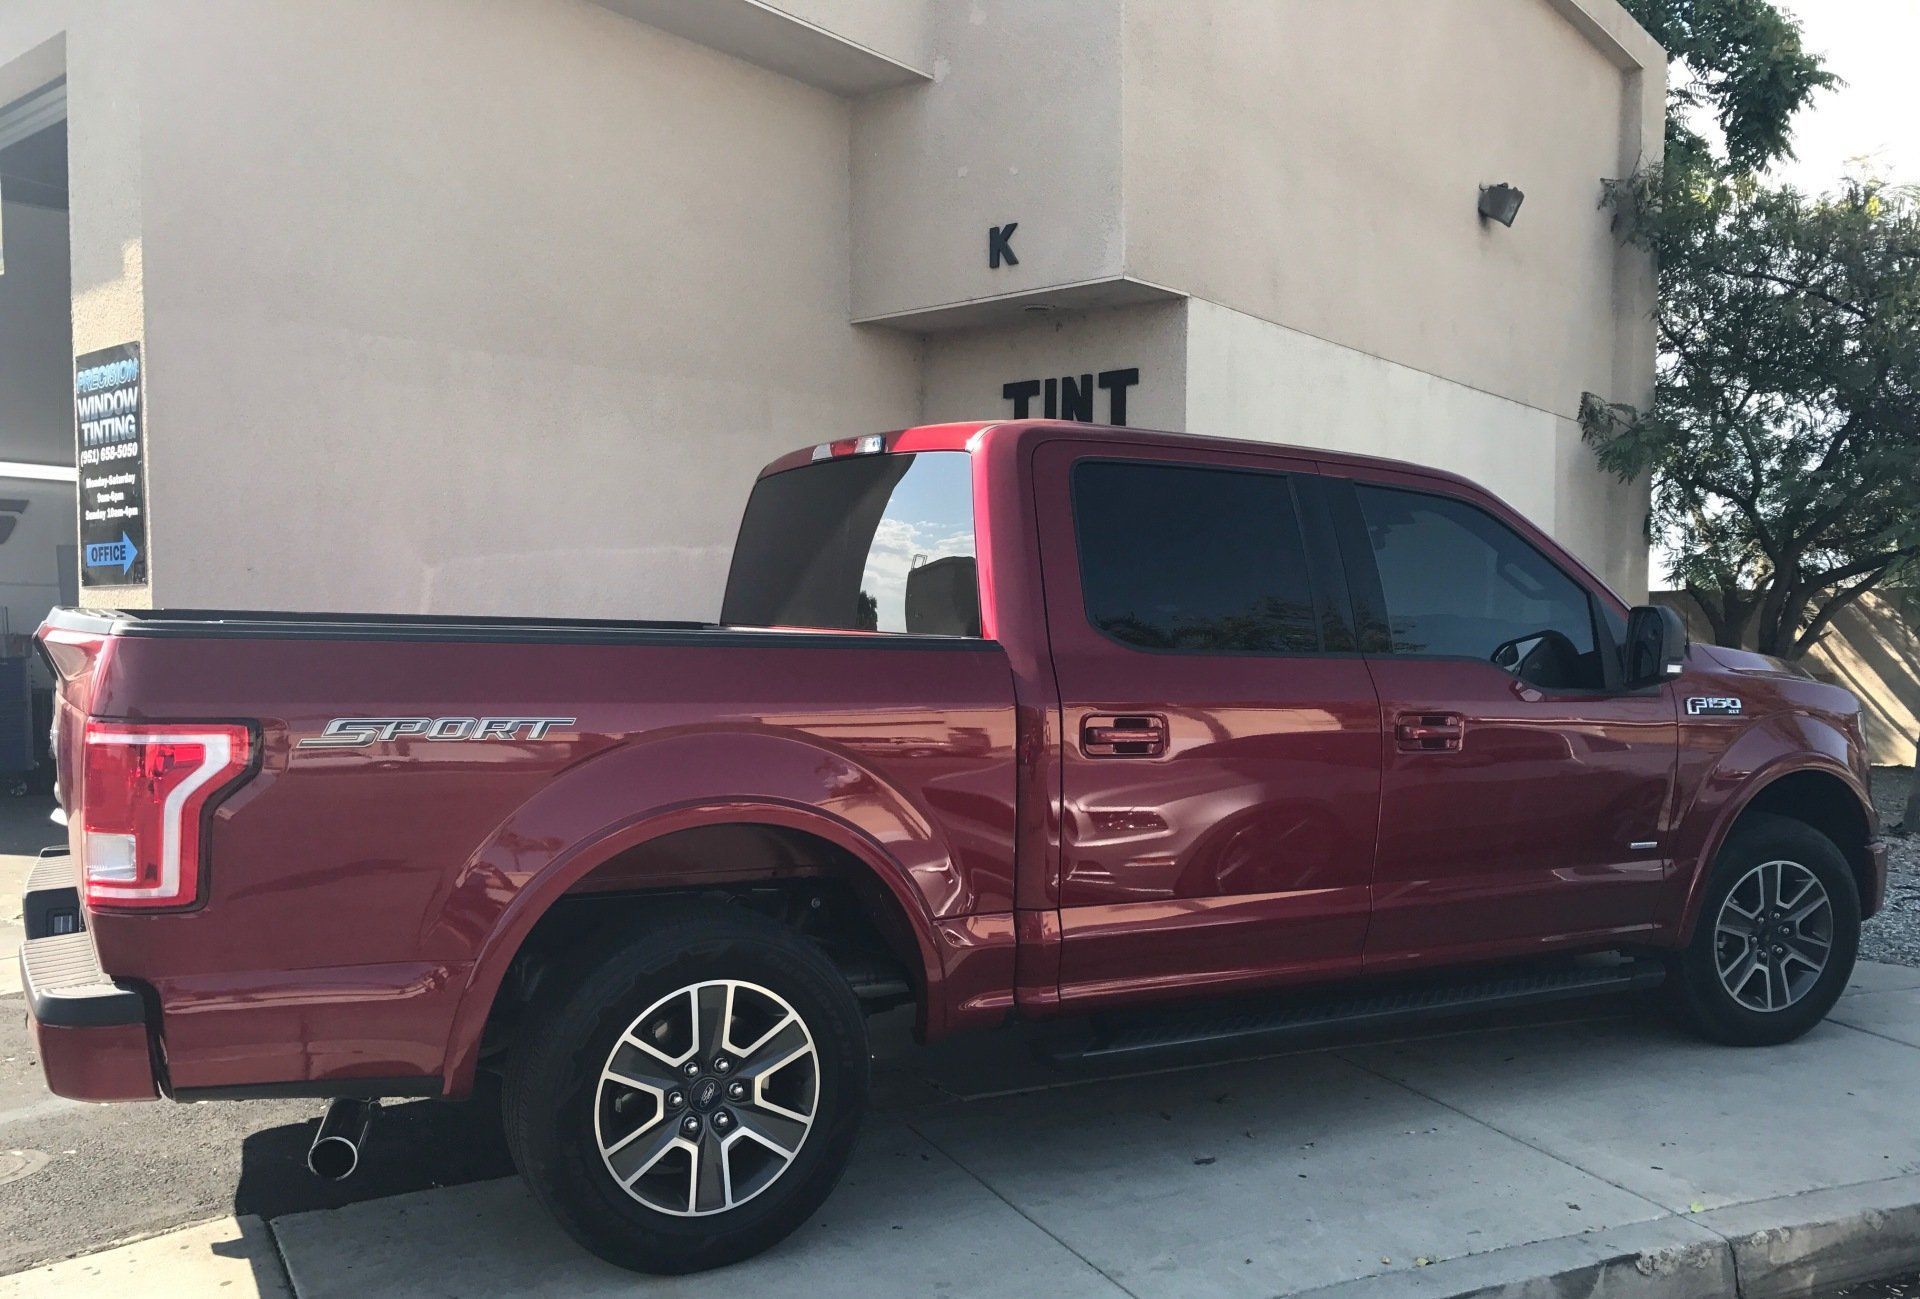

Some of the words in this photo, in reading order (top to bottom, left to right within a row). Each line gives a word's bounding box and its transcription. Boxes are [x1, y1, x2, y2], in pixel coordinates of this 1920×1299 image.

[989, 222, 1020, 269] K
[77, 358, 139, 393] PRECISION
[77, 386, 138, 421] WINDOW
[1003, 368, 1140, 426] TINT
[81, 413, 136, 447] TINTING
[91, 544, 127, 562] OFFICE
[296, 717, 577, 749] SPORT
